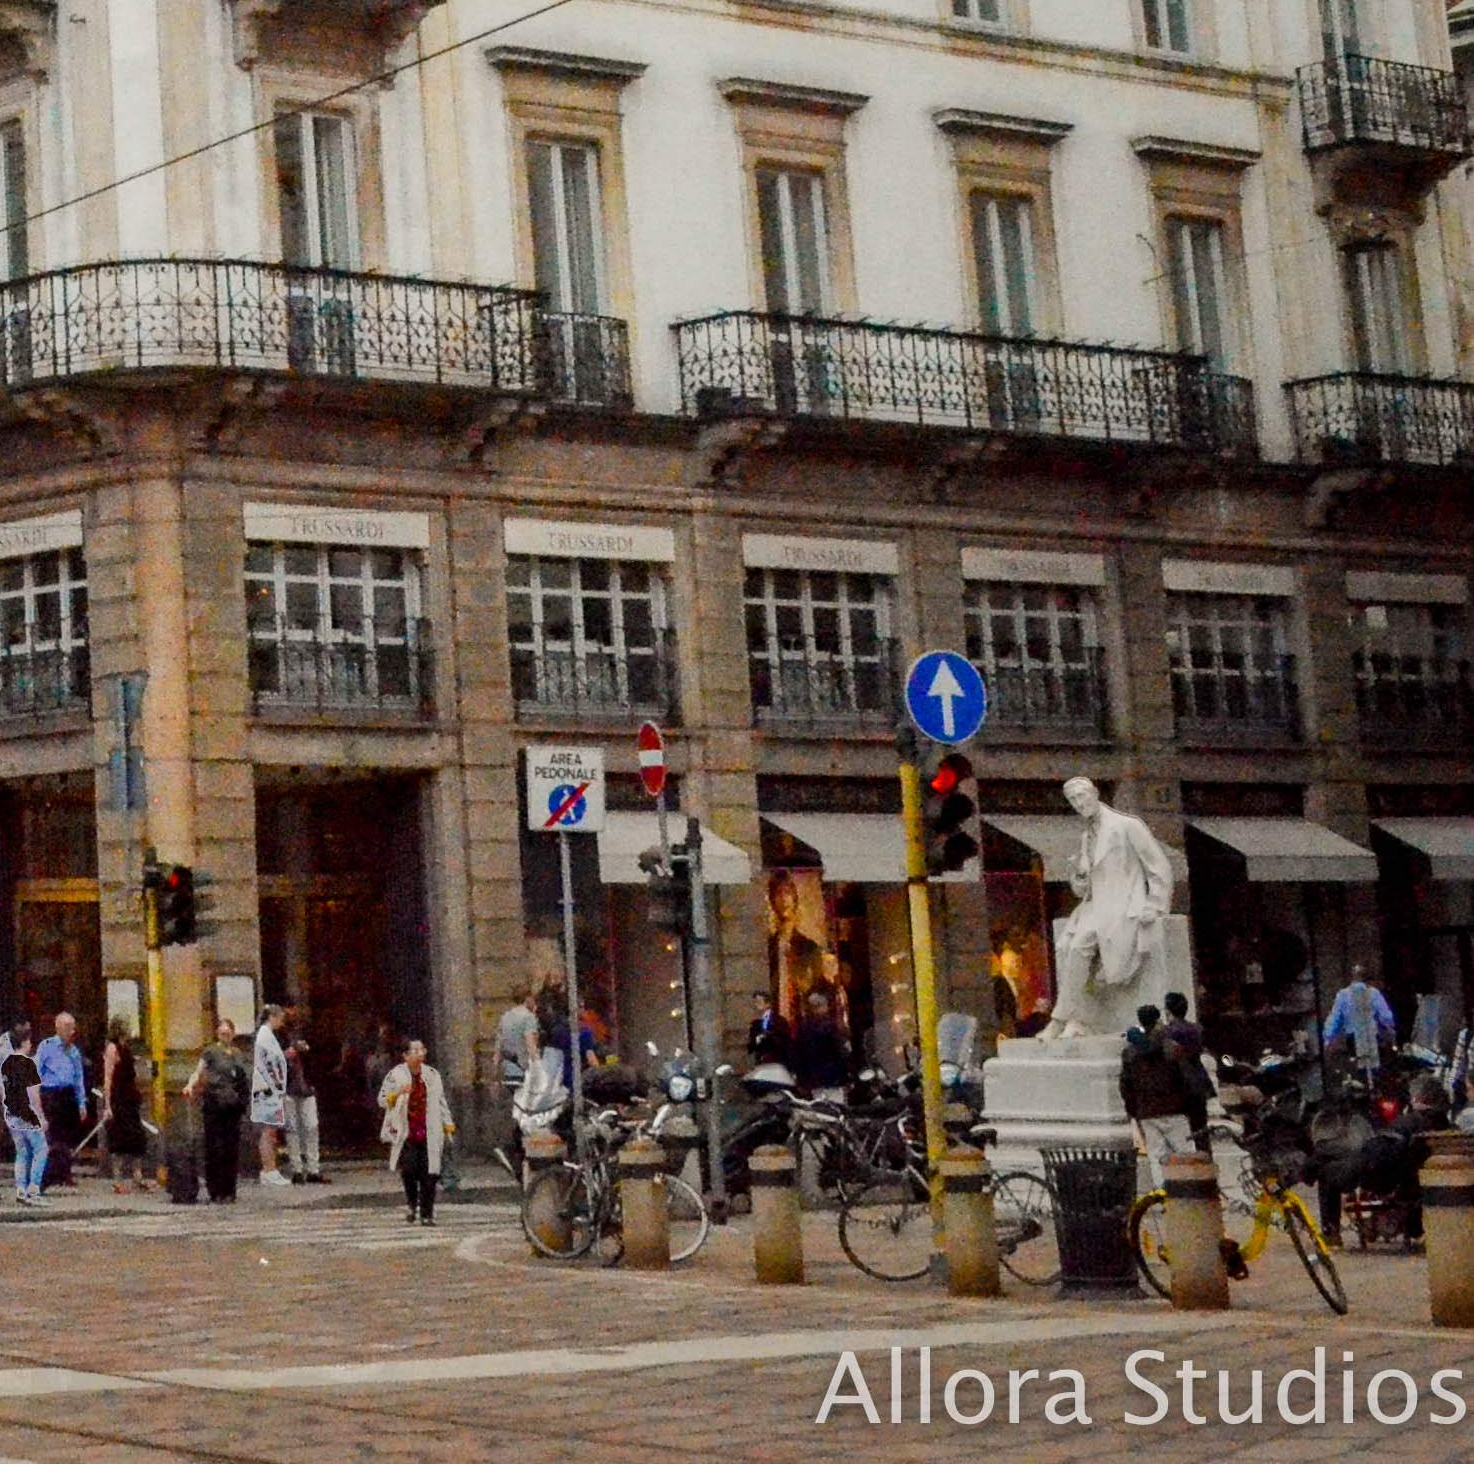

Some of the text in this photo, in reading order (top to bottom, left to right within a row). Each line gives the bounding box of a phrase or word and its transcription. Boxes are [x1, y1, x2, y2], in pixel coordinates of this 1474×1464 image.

[291, 516, 385, 539] TRUSSARDI
[548, 532, 633, 553] TRUSSARDI
[550, 752, 583, 765] AREA
[534, 765, 598, 780] PEDONALE
